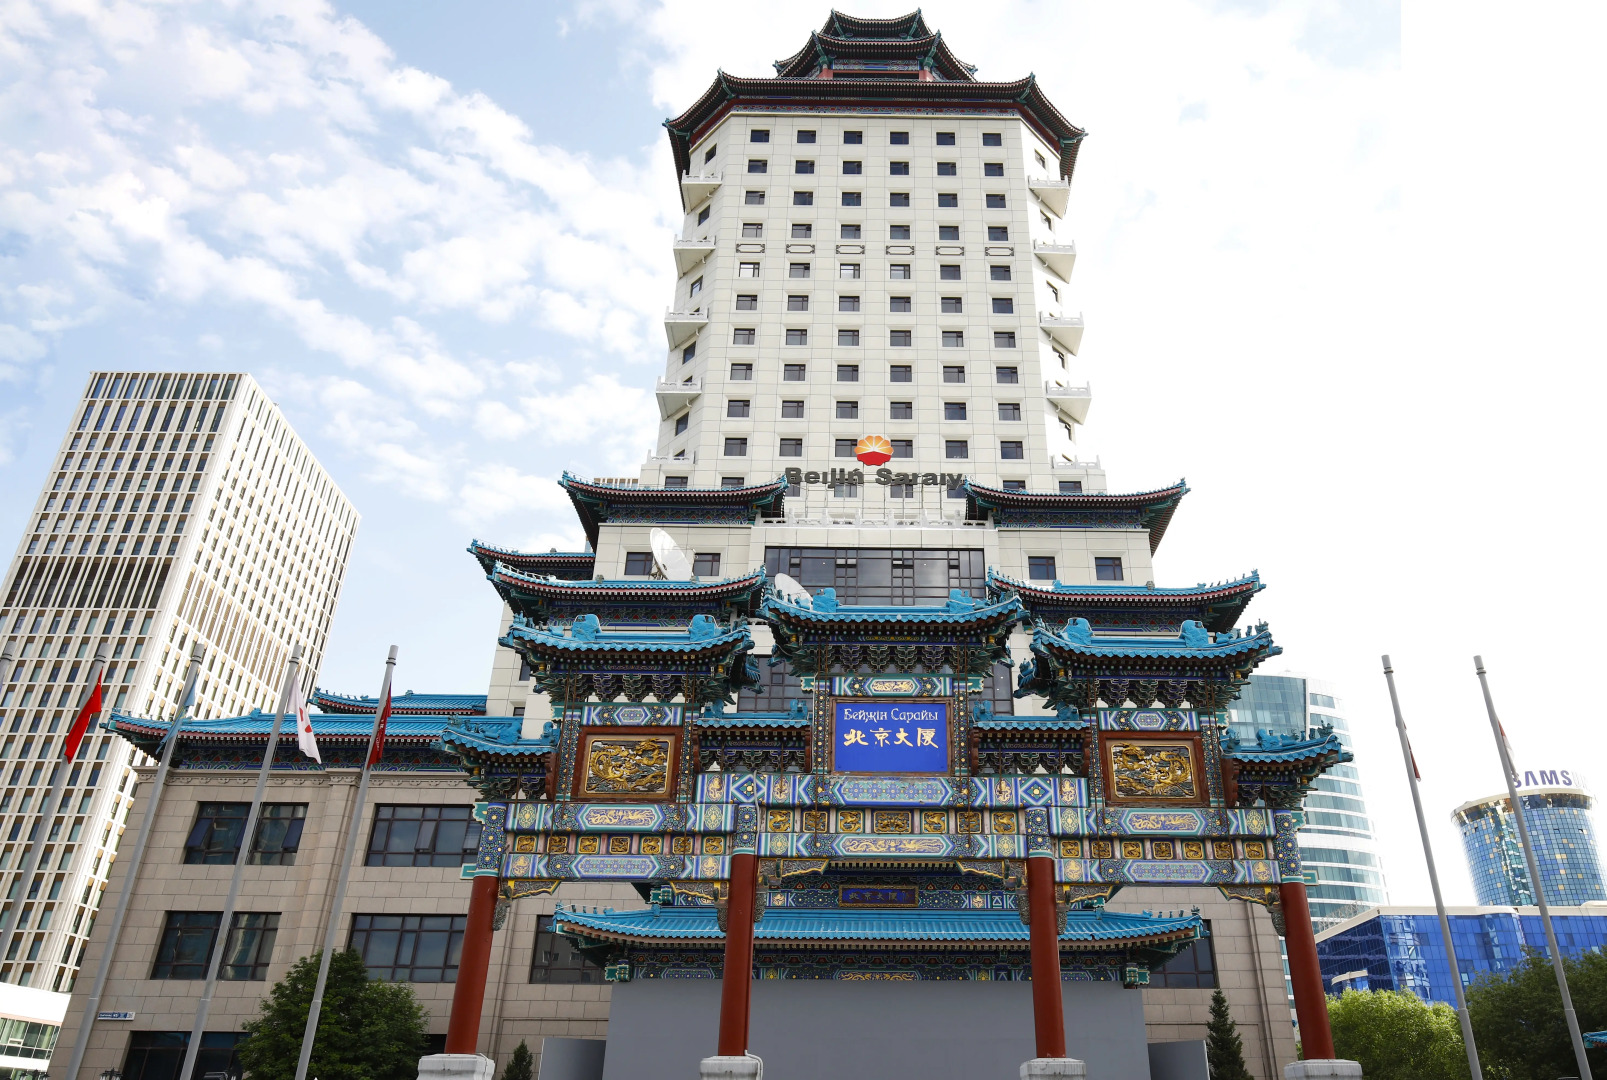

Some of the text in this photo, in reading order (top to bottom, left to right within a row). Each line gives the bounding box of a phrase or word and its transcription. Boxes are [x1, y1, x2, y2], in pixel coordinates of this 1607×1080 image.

[890, 708, 938, 723] Сарайы
[843, 727, 939, 749] 北京大厦
